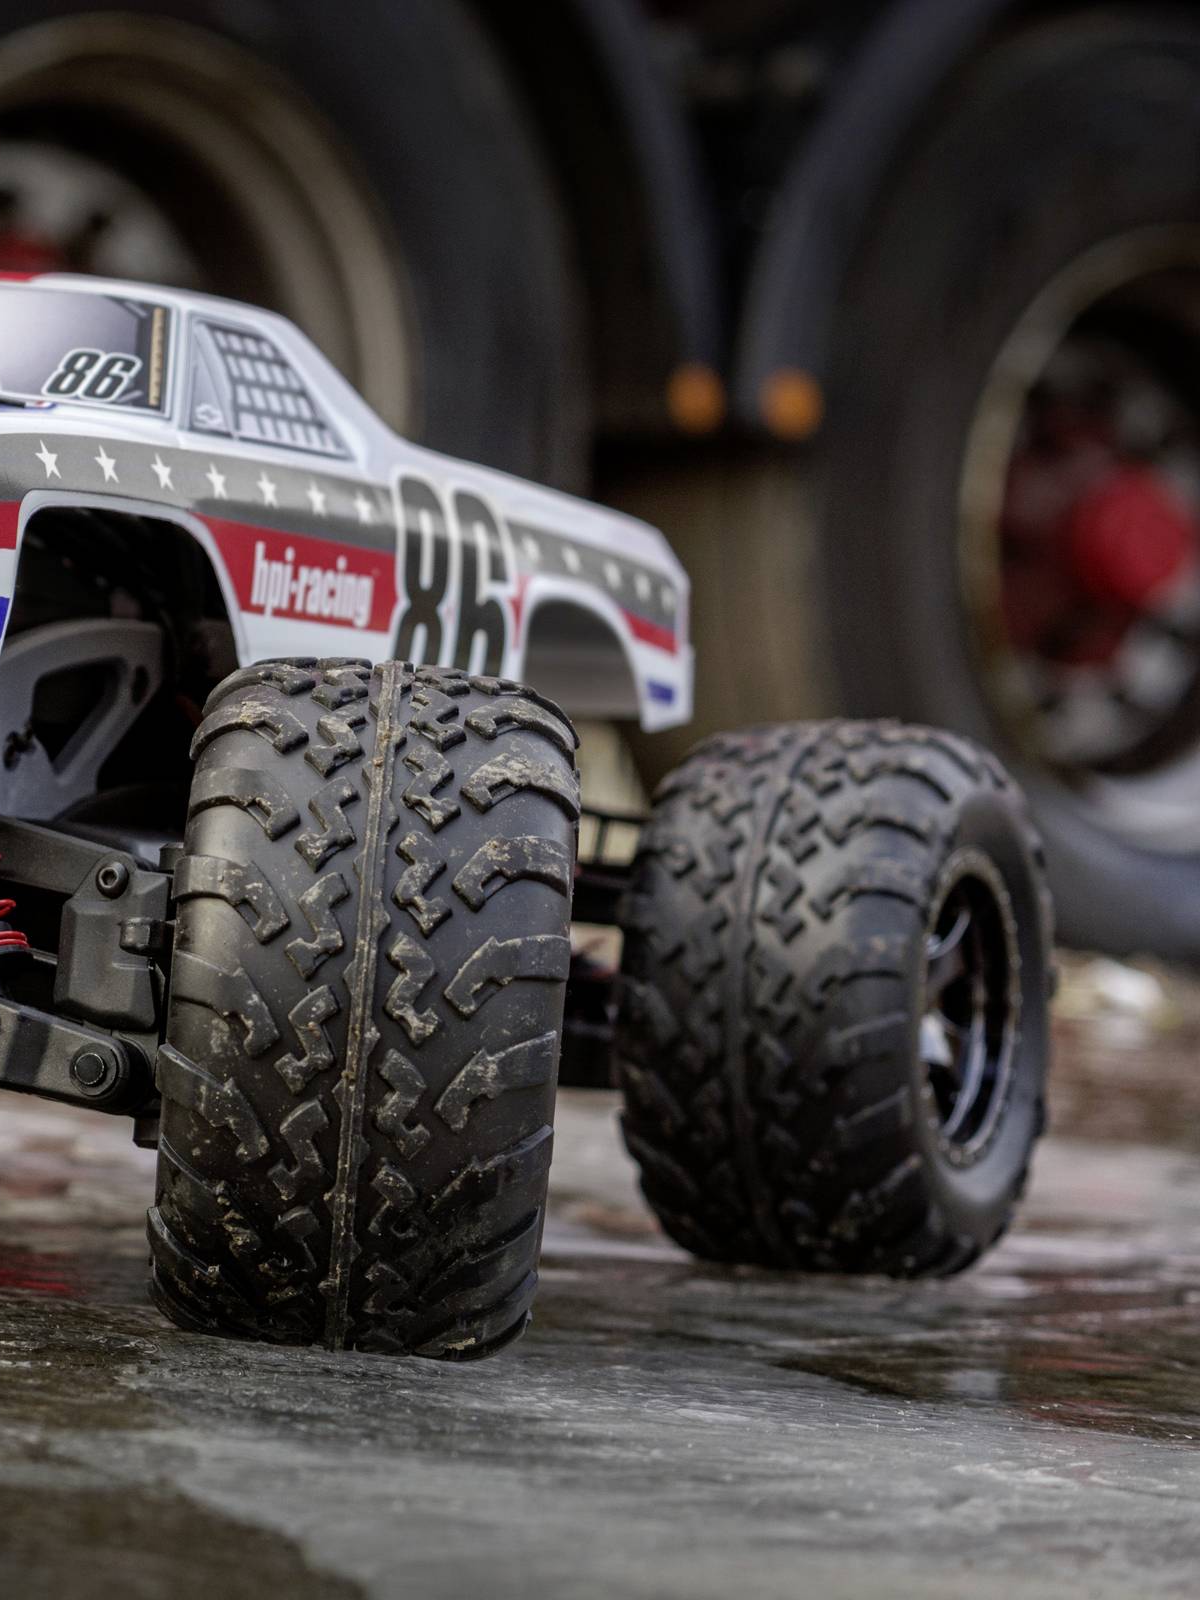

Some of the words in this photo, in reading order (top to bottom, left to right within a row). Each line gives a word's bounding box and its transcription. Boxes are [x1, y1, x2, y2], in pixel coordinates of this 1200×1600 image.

[44, 350, 141, 401] 86
[250, 540, 375, 629] hpi-racing
[391, 474, 513, 677] 86
